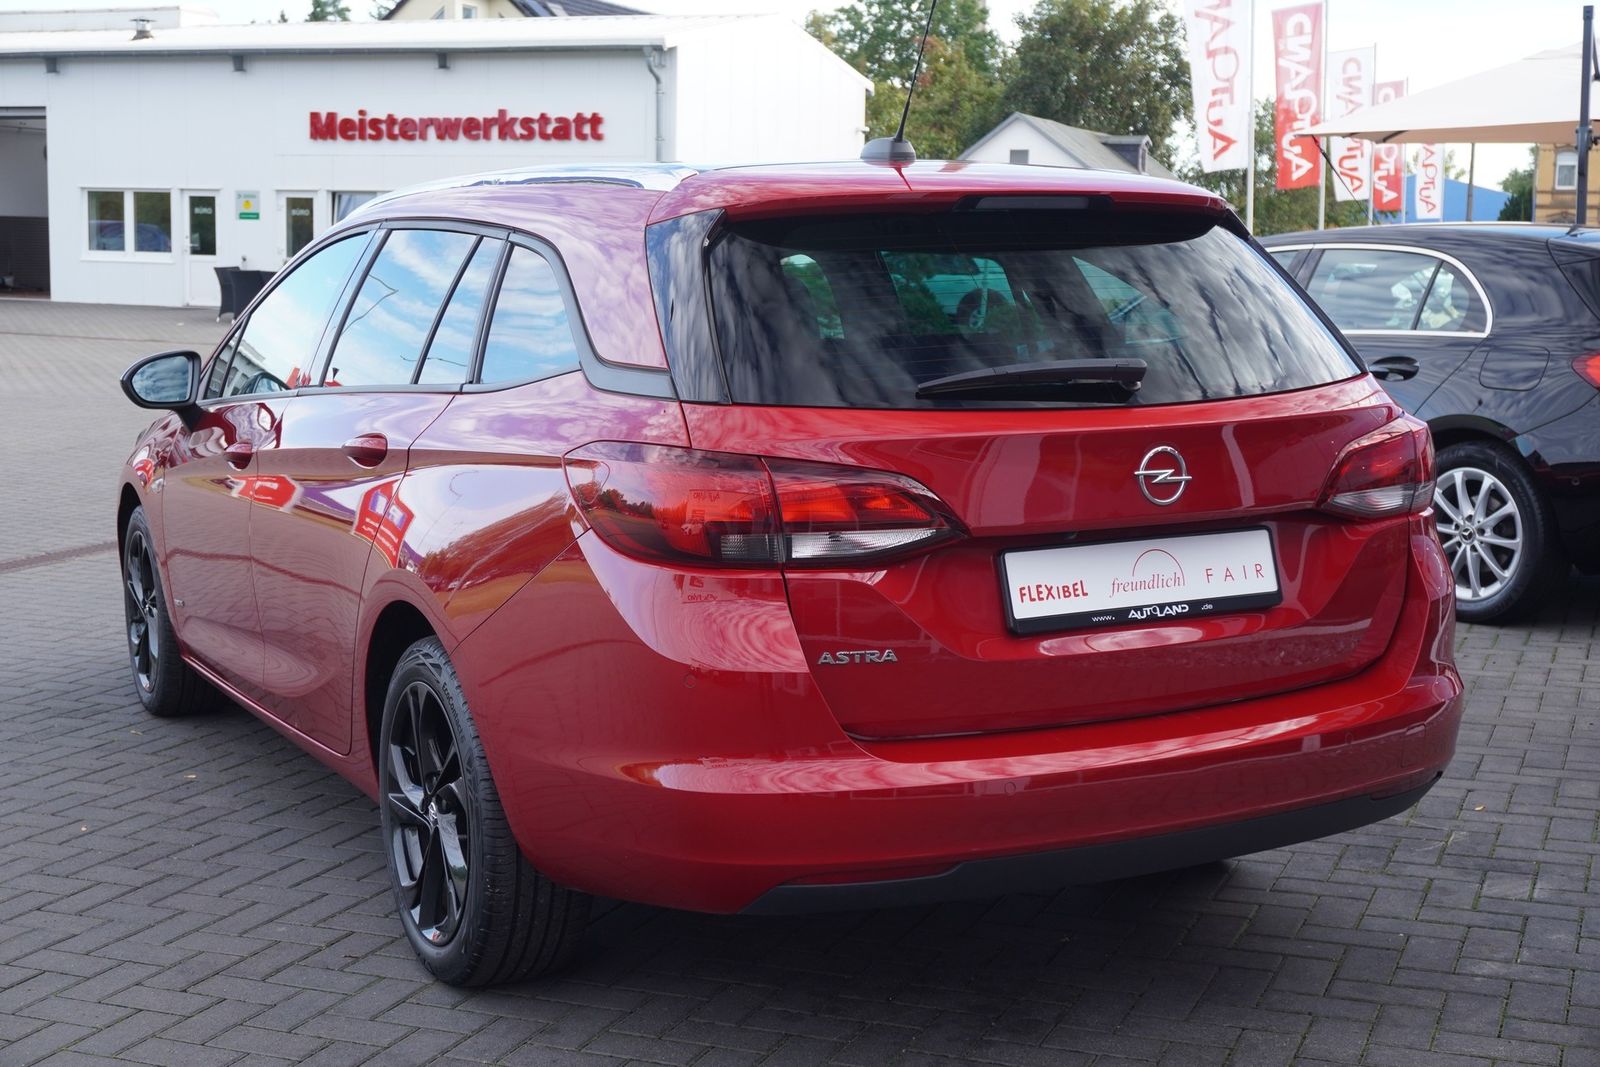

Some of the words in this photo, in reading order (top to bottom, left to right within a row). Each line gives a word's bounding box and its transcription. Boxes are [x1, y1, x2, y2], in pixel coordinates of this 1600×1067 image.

[309, 109, 604, 141] Meisterwerkstatt
[1019, 580, 1088, 603] FLEXIBEL
[1109, 572, 1181, 598] freundlich
[818, 649, 898, 665] ASTRA
